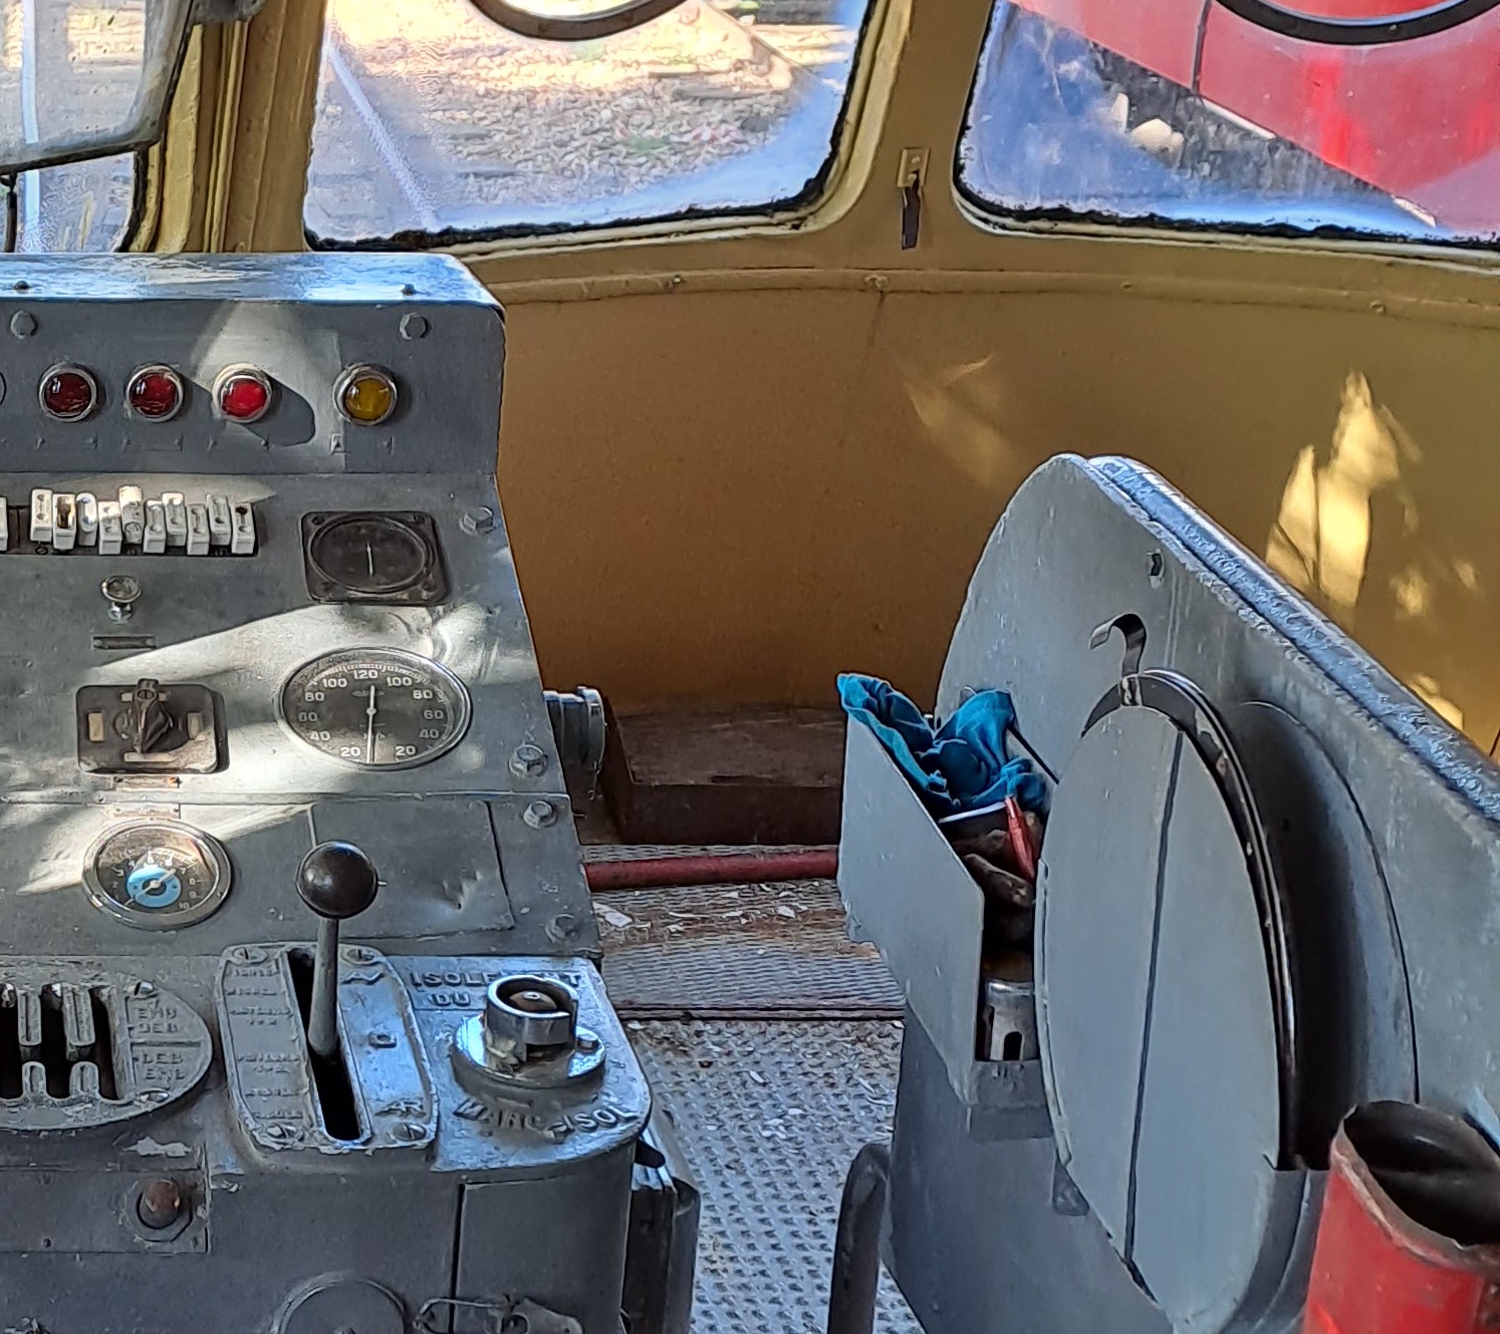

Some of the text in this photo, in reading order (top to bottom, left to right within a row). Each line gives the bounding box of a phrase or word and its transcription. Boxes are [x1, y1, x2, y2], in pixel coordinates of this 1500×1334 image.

[353, 669, 379, 680] 120
[322, 678, 348, 689] 100
[386, 676, 413, 687] 100
[304, 691, 325, 702] 80
[412, 689, 434, 700] 80
[298, 711, 319, 722] 60
[423, 709, 445, 720] 60
[309, 730, 331, 742] 40
[418, 728, 440, 739] 40
[339, 746, 361, 758] 20
[395, 745, 416, 757] 20
[178, 902, 191, 910] 10
[342, 970, 386, 985] AV
[431, 992, 472, 1007] DU
[373, 1097, 427, 1117] AR
